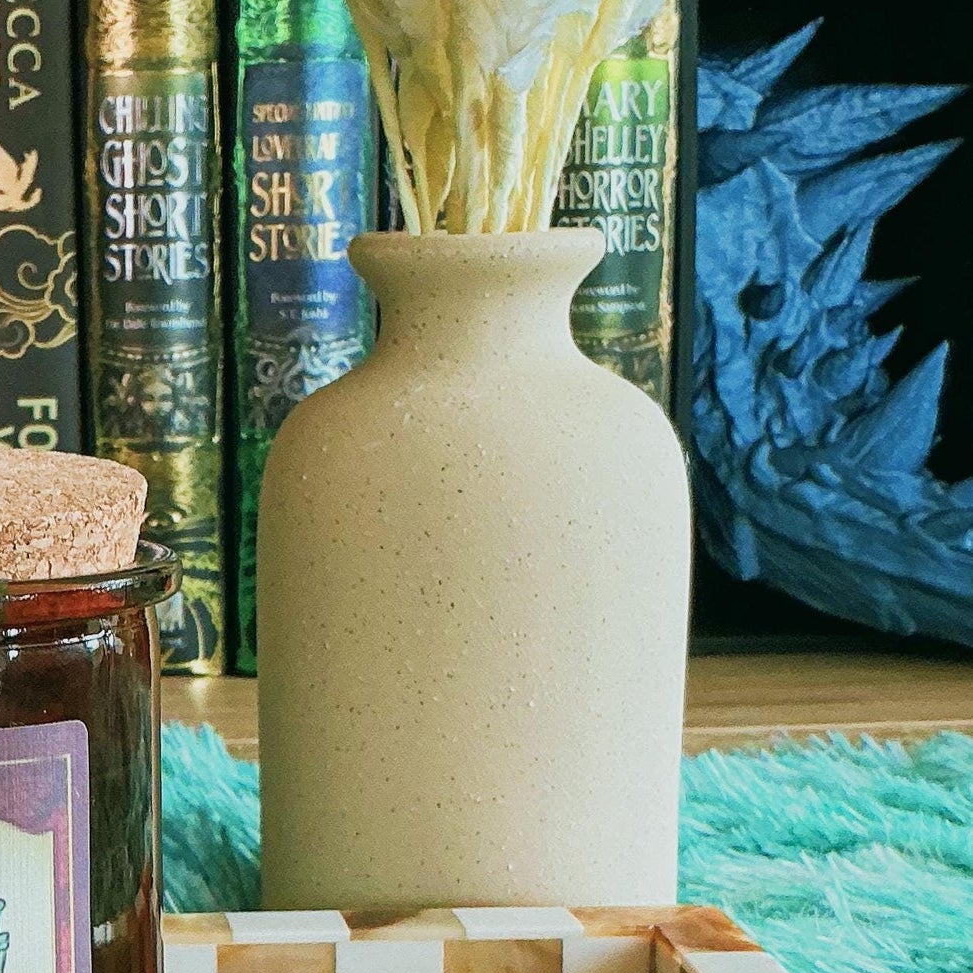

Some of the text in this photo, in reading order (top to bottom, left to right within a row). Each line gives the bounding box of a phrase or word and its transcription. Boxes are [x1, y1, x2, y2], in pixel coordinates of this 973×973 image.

[6, 0, 42, 110] CCA
[582, 79, 663, 122] ARY
[100, 136, 208, 189] GHOST
[250, 170, 350, 220] SHR
[558, 167, 660, 214] HORROR
[105, 190, 208, 242] SHORT
[556, 211, 662, 257] RIES
[103, 240, 211, 285] STORIES
